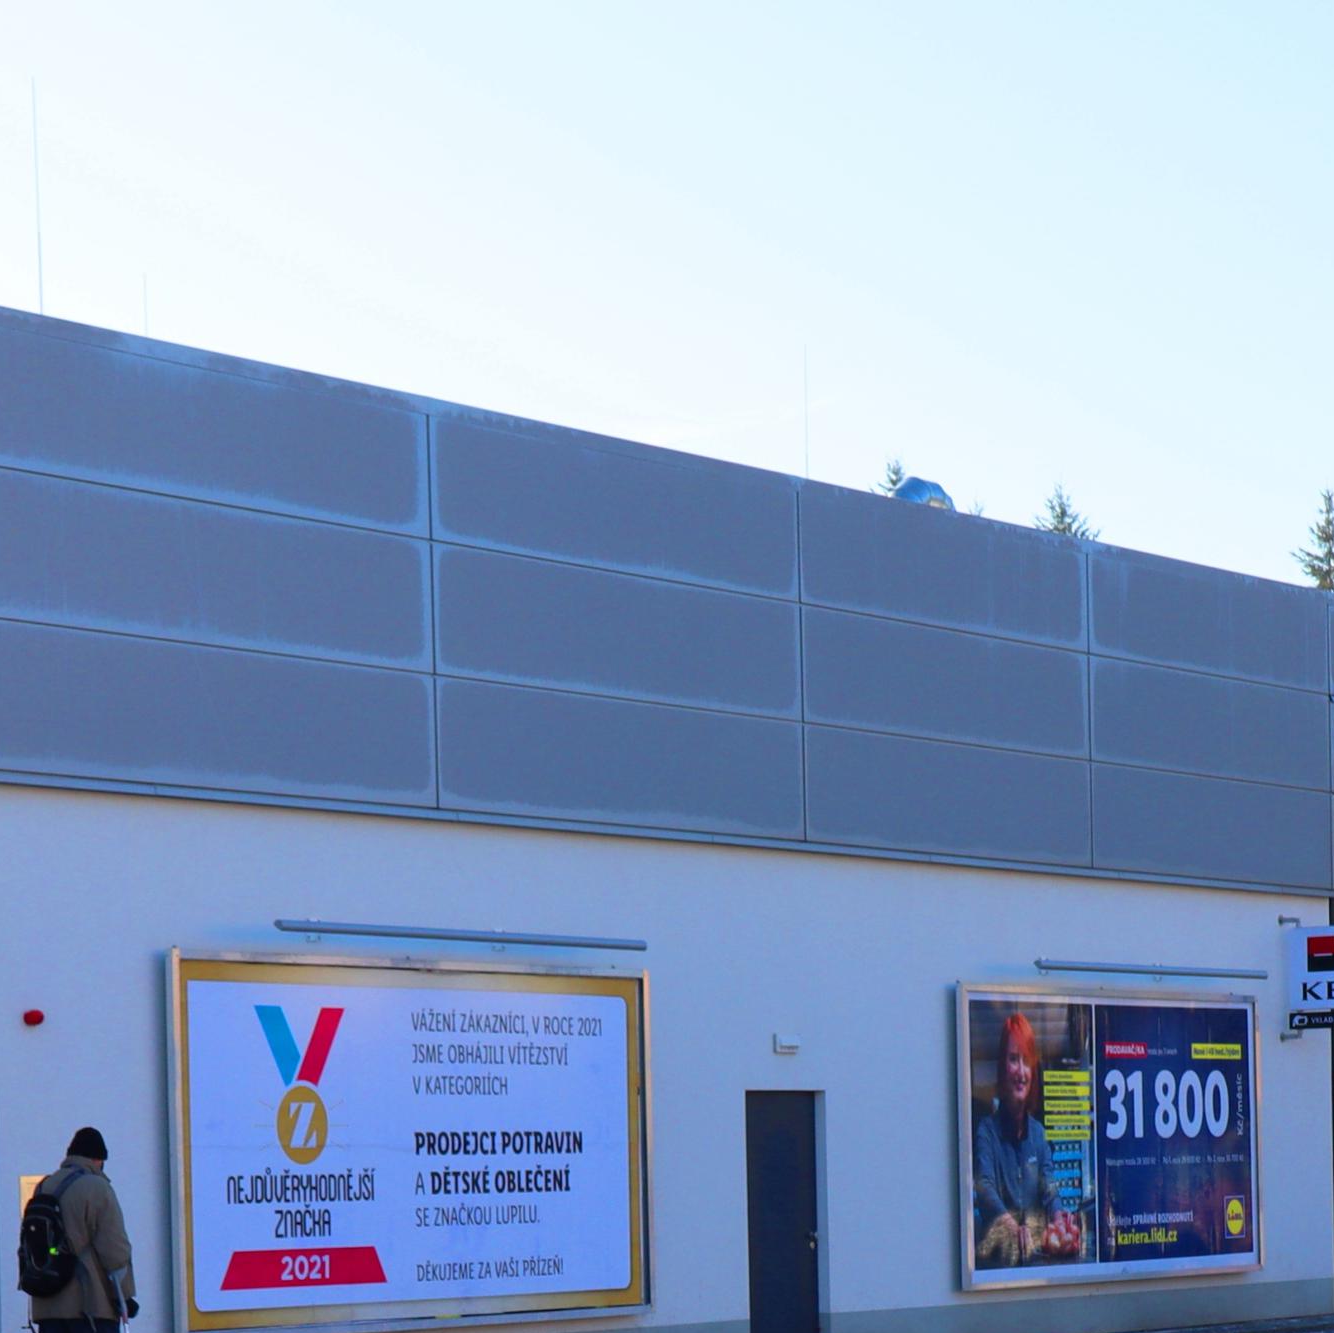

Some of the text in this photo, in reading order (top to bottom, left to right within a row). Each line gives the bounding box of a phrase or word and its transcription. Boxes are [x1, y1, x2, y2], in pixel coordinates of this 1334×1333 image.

[411, 1008, 602, 1036] VÁŽENÍ ZÁKAZNÍCI, V ROCE 2021
[412, 1041, 568, 1066] JSME OBHÁJILI VÍTĚZSTVÍ
[412, 1072, 508, 1096] V KATEGORIÍCH
[1104, 1069, 1229, 1140] 31 800
[288, 1101, 317, 1149] Z
[414, 1131, 583, 1156] PRODEJCI POTRAVIN
[227, 1167, 375, 1205] NEJDŮVĚRYHODNĚJŠÍ
[415, 1164, 571, 1195] A DĚTSKÉ OBLEČENÍ
[274, 1206, 332, 1238] ZNAČKA
[415, 1203, 540, 1227] SE ZNAČKOU LUPILU.
[1117, 1227, 1177, 1245] kariera.lidl.cz
[281, 1255, 330, 1281] 2021
[417, 1255, 564, 1282] DĚKUJEME ZA VAŠI PŘÍZEŇ!
